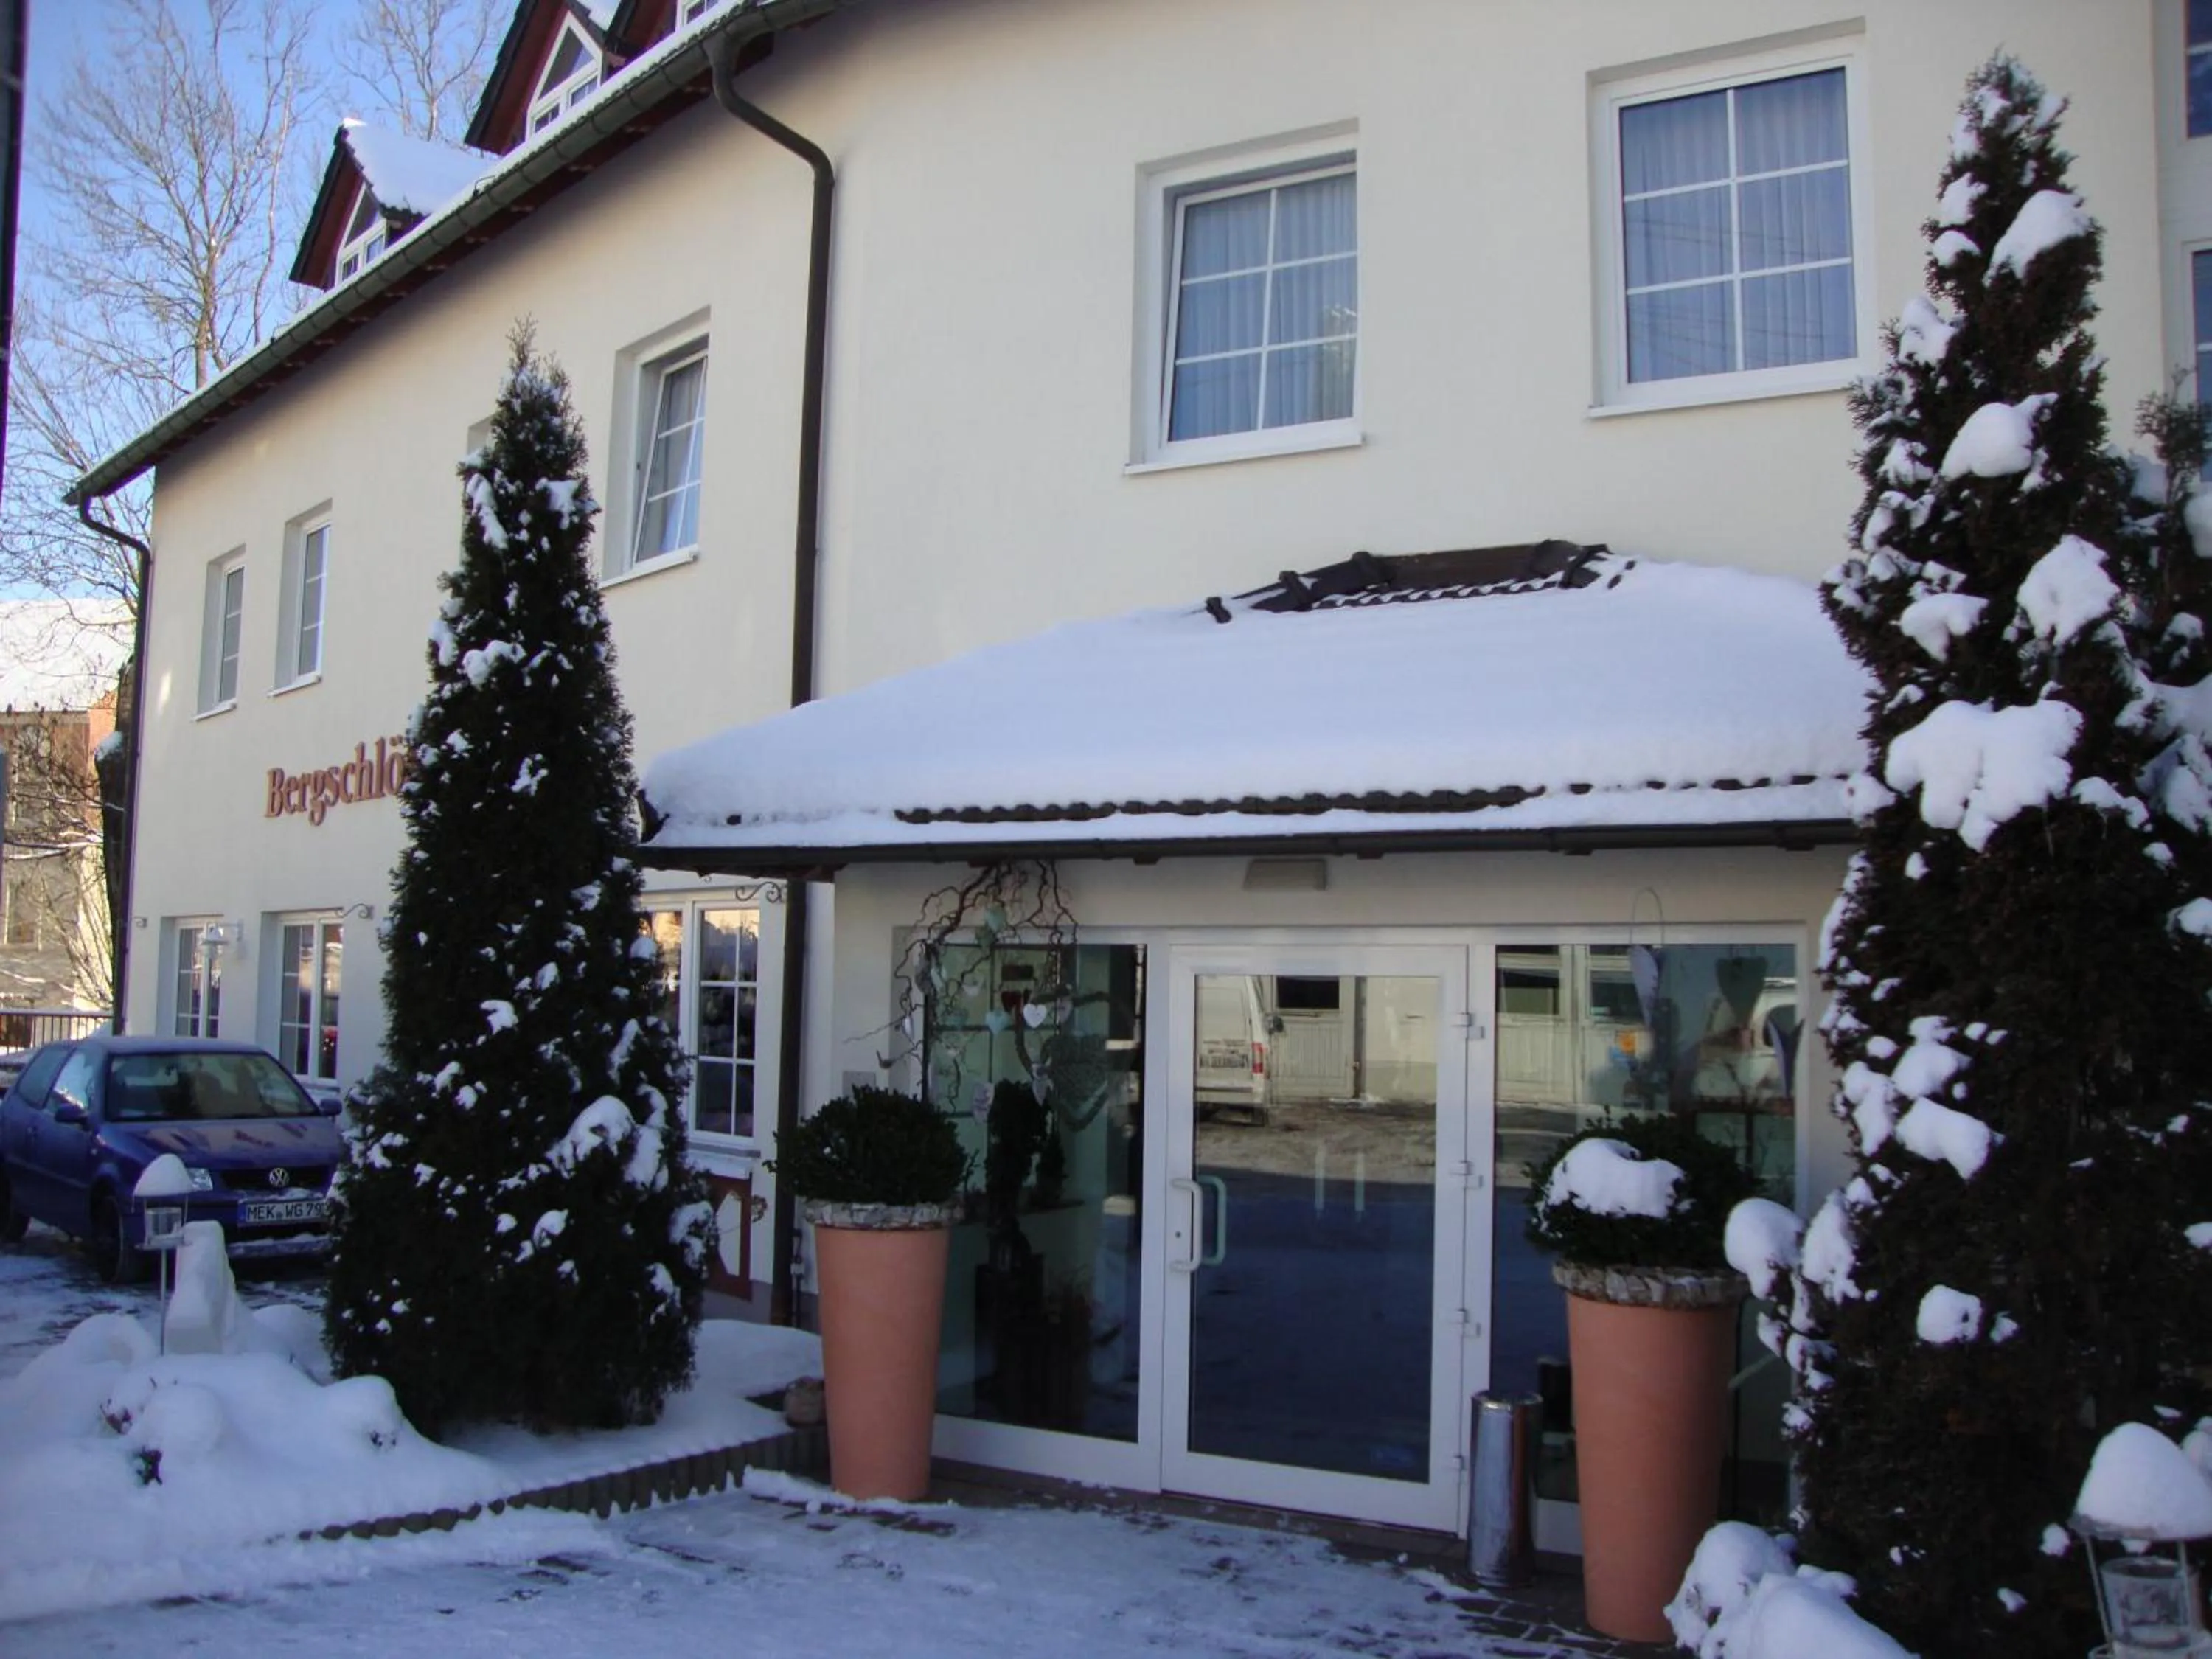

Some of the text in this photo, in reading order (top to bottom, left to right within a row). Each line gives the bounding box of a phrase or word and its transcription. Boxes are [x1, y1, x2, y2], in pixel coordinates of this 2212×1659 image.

[265, 735, 406, 826] Bergschlö
[247, 1205, 276, 1220] MEK
[306, 1202, 327, 1217] 79
